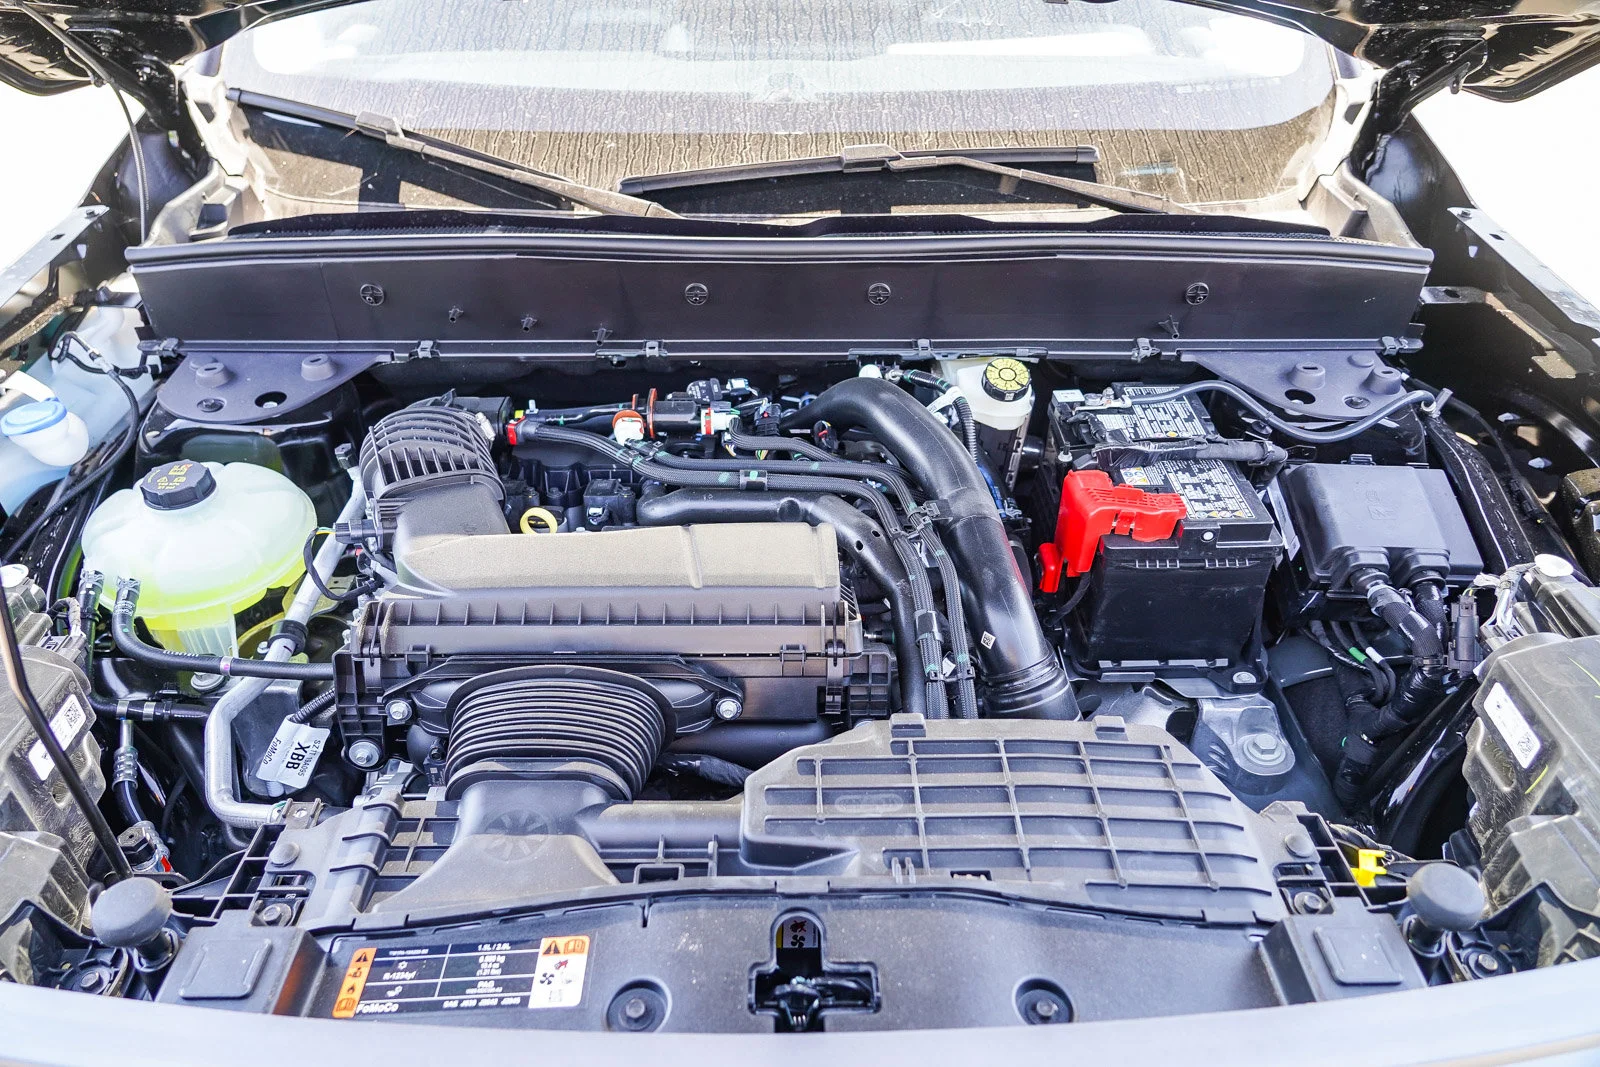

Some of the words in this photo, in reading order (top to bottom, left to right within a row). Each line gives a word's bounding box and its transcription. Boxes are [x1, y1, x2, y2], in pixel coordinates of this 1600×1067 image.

[263, 737, 282, 765] FoMoCo
[286, 741, 311, 770] XBB
[356, 1002, 399, 1014] FoMoCo
